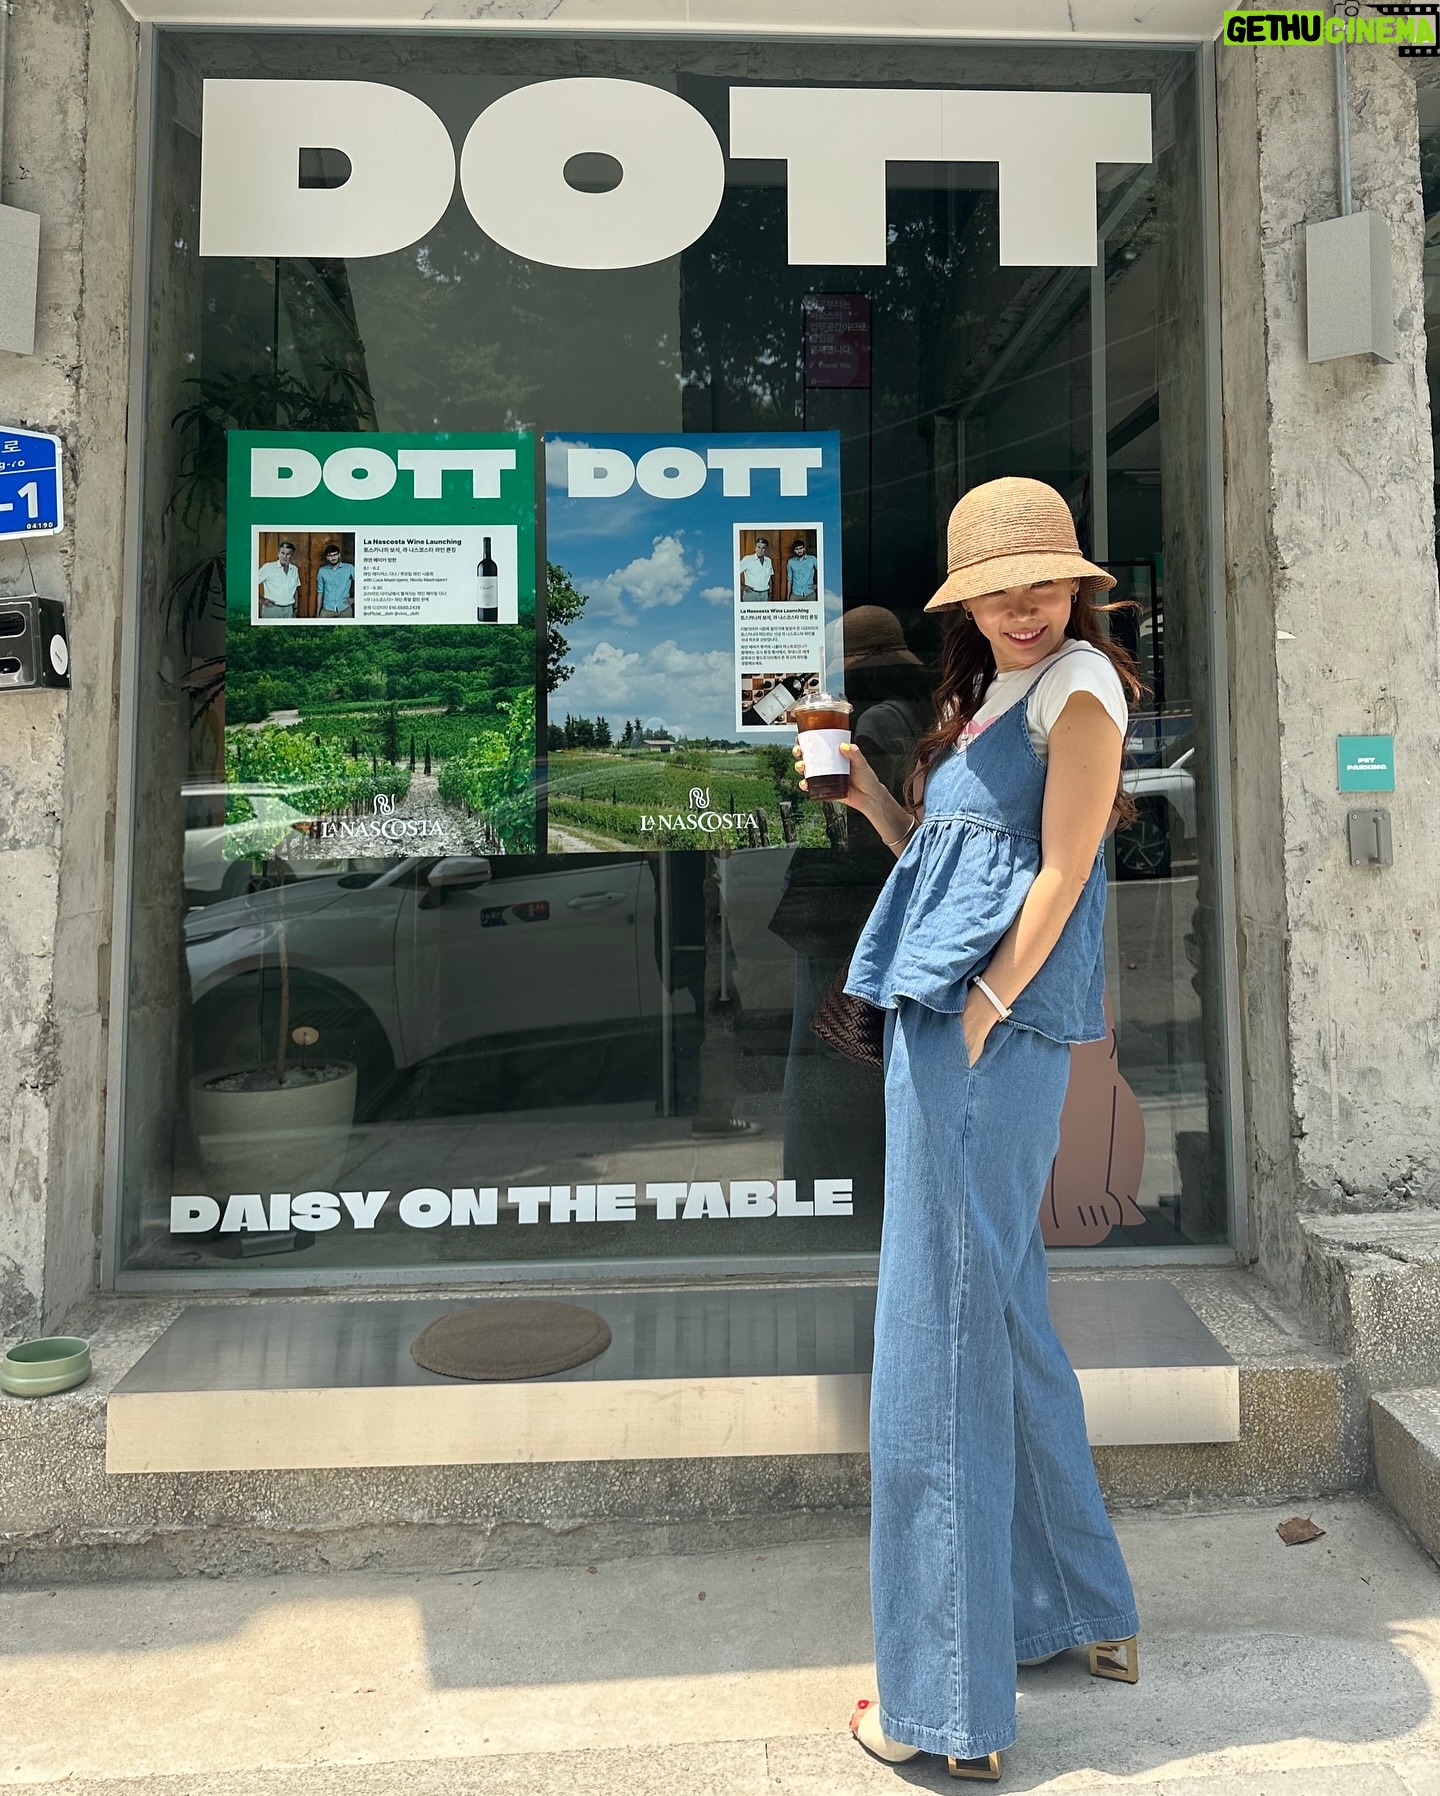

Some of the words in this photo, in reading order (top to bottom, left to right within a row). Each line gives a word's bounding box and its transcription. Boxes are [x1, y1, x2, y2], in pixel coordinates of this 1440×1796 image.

[199, 77, 1152, 269] DOTT
[1, 440, 21, 453] 로
[250, 447, 516, 500] DOTT
[567, 446, 822, 499] DOTT
[363, 538, 372, 546] La
[373, 538, 405, 546] Nascosta
[406, 538, 425, 546] Wine
[426, 538, 462, 546] Launching
[340, 818, 445, 840] NASCOSTA
[658, 811, 758, 832] NASCOSTA
[170, 1191, 390, 1233] DAISY
[399, 1188, 498, 1228] ON
[508, 1184, 636, 1224] THE
[646, 1178, 854, 1220] TABLE
